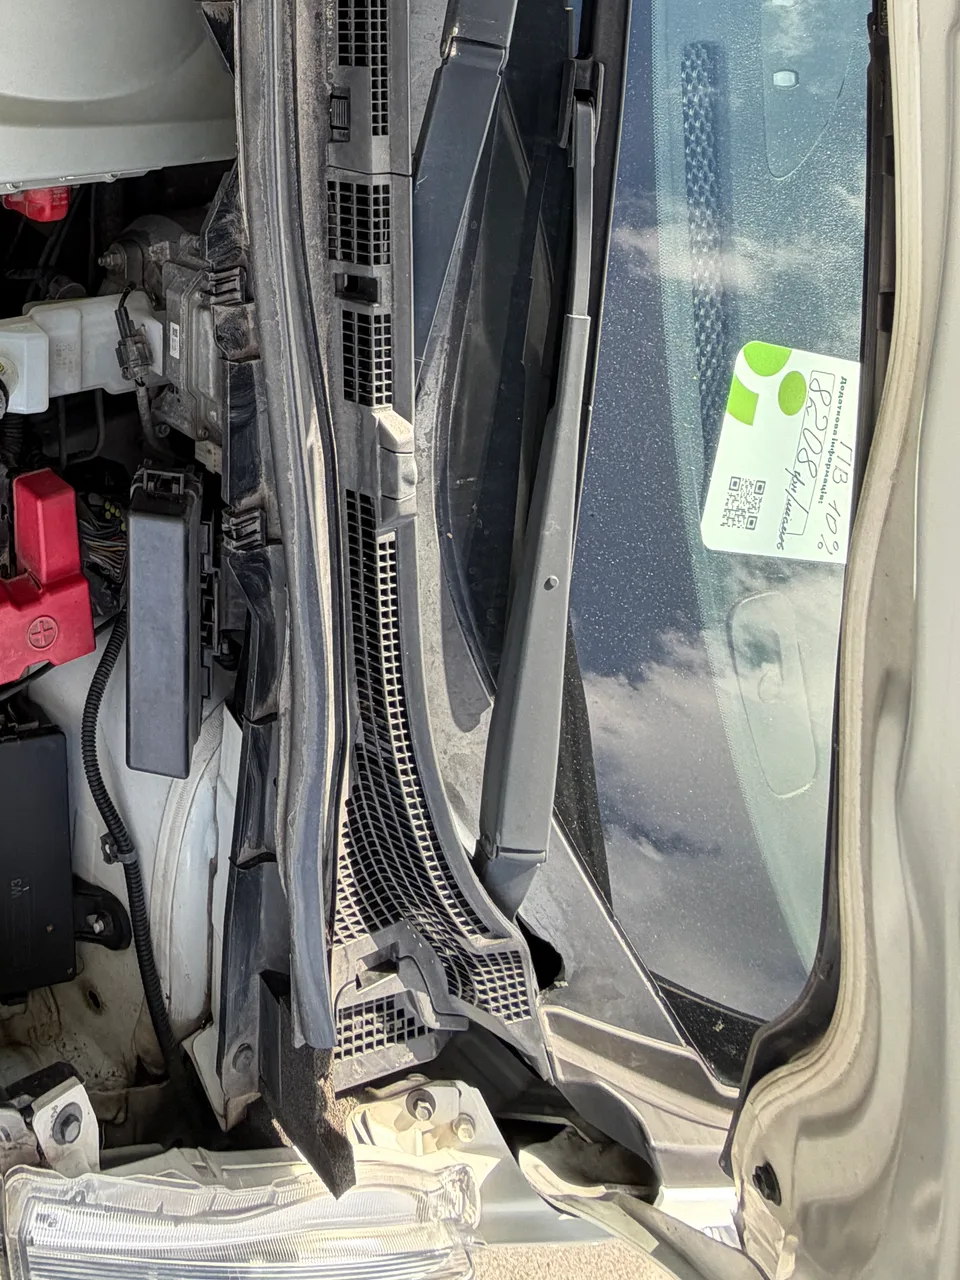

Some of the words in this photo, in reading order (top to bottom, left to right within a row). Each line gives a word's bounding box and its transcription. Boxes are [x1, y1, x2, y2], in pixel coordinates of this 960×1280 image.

[796, 378, 832, 478] 8208
[832, 376, 848, 436] Додаткова
[817, 438, 839, 504] інформація:
